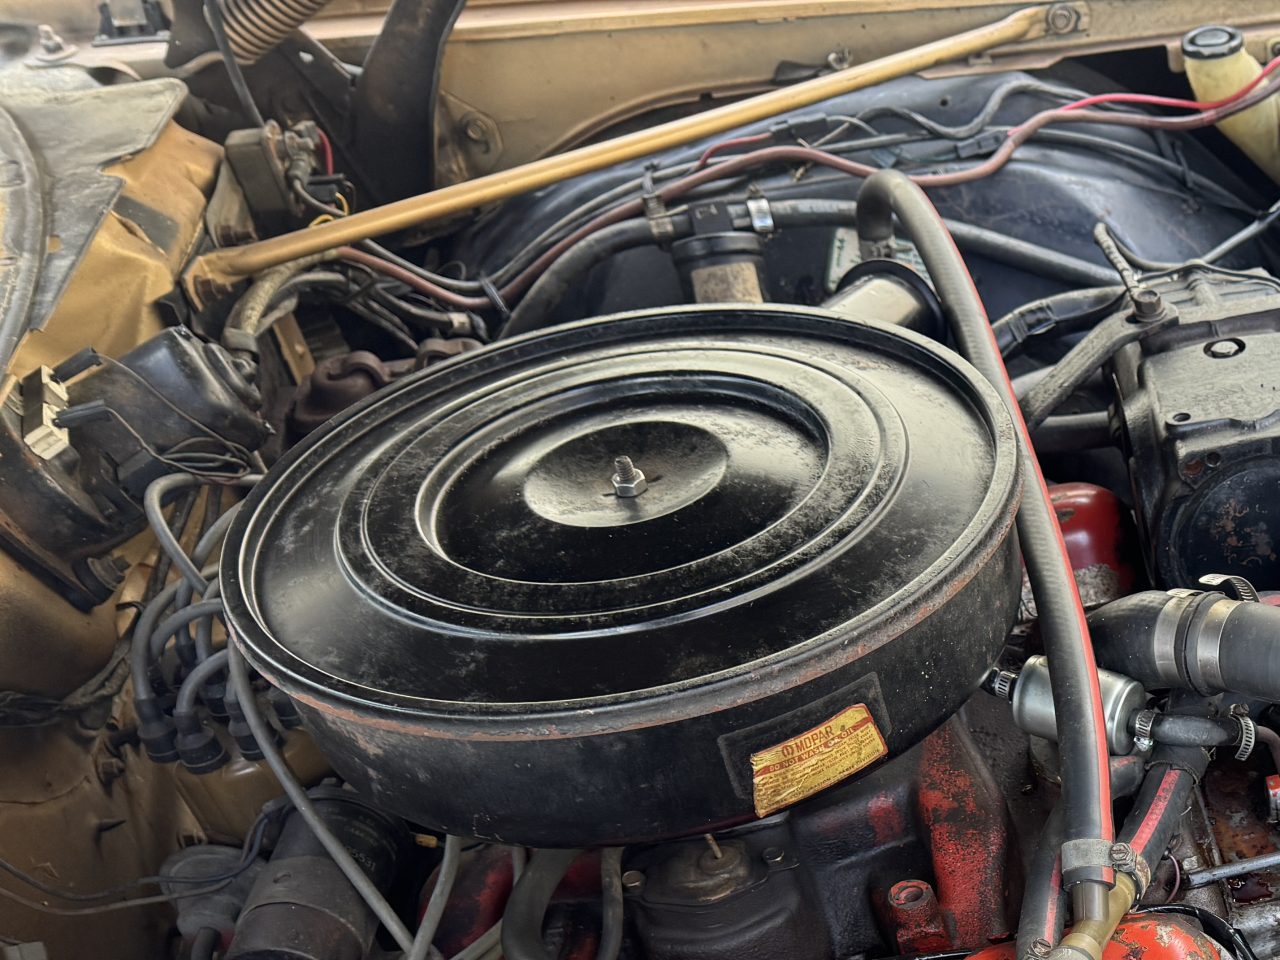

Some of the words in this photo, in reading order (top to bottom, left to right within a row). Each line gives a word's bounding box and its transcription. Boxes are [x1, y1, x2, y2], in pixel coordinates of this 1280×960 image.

[768, 762, 780, 771] DO
[782, 756, 799, 768] NOT
[800, 744, 825, 760] WASH
[826, 735, 840, 746] OR
[840, 726, 854, 738] OIL
[795, 725, 834, 752] MOPAR
